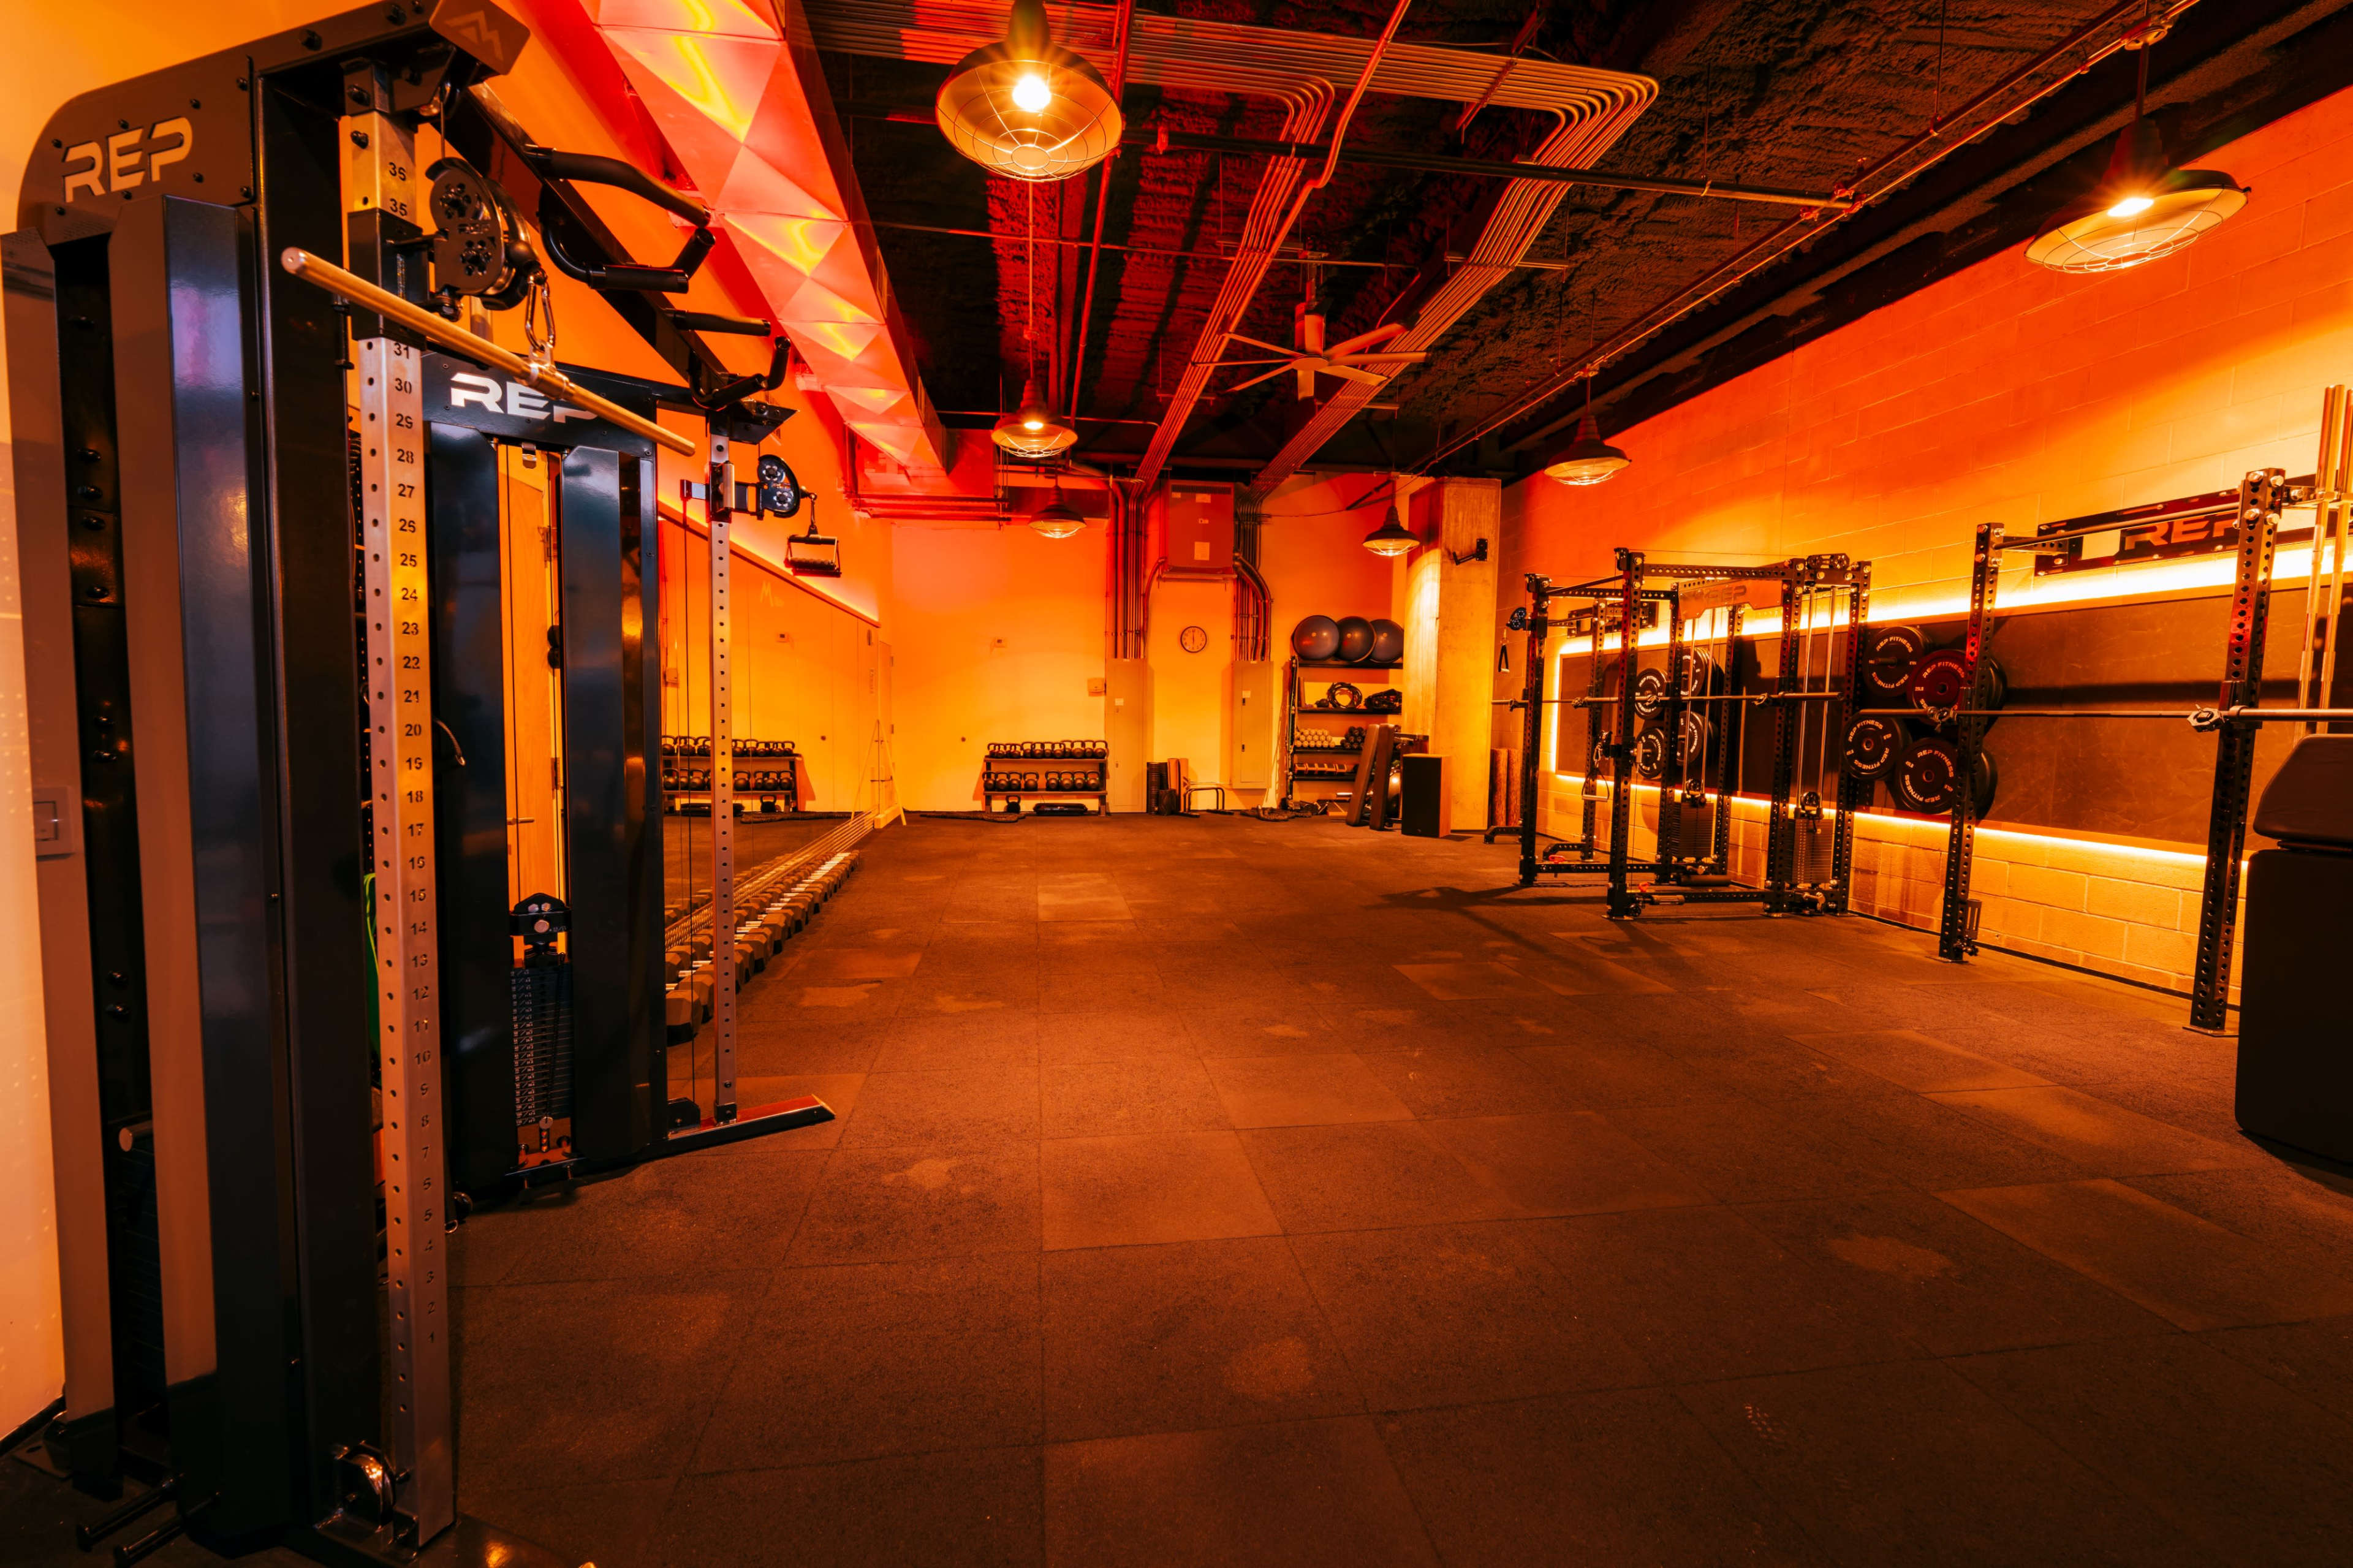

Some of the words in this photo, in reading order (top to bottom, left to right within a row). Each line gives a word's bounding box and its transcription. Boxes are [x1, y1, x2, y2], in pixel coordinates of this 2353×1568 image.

[63, 116, 192, 202] REP
[389, 198, 407, 217] 35
[394, 343, 410, 359] 31
[395, 377, 412, 394] 30
[396, 414, 413, 429] 29
[397, 449, 414, 464] 28
[398, 483, 415, 499] 27
[399, 518, 416, 533] 26
[400, 553, 417, 567] 25
[401, 588, 418, 602] 24
[402, 622, 419, 636] 23
[1876, 638, 1888, 651] REP
[1890, 636, 1912, 653] FITNESS
[403, 656, 420, 669] 22
[1923, 665, 1936, 678] REP
[1938, 662, 1965, 678] FITNESS
[404, 691, 419, 703] 21
[405, 724, 422, 737] 20
[1857, 720, 1883, 729] FITNESS
[1881, 748, 1889, 763] REP
[406, 757, 422, 770] 19
[1854, 759, 1881, 770] FITNESS
[1934, 750, 1954, 777] FITNESS
[1905, 775, 1923, 801] FITNESS
[407, 790, 423, 803] 18
[407, 824, 424, 836] 17
[409, 889, 426, 901] 15
[411, 922, 427, 934] 14
[412, 954, 428, 967] 13
[412, 986, 429, 999] 12
[414, 1050, 430, 1064] 10
[422, 1115, 429, 1127] 8
[422, 1146, 430, 1159] 7
[424, 1208, 433, 1221] 5
[427, 1301, 436, 1314] 2
